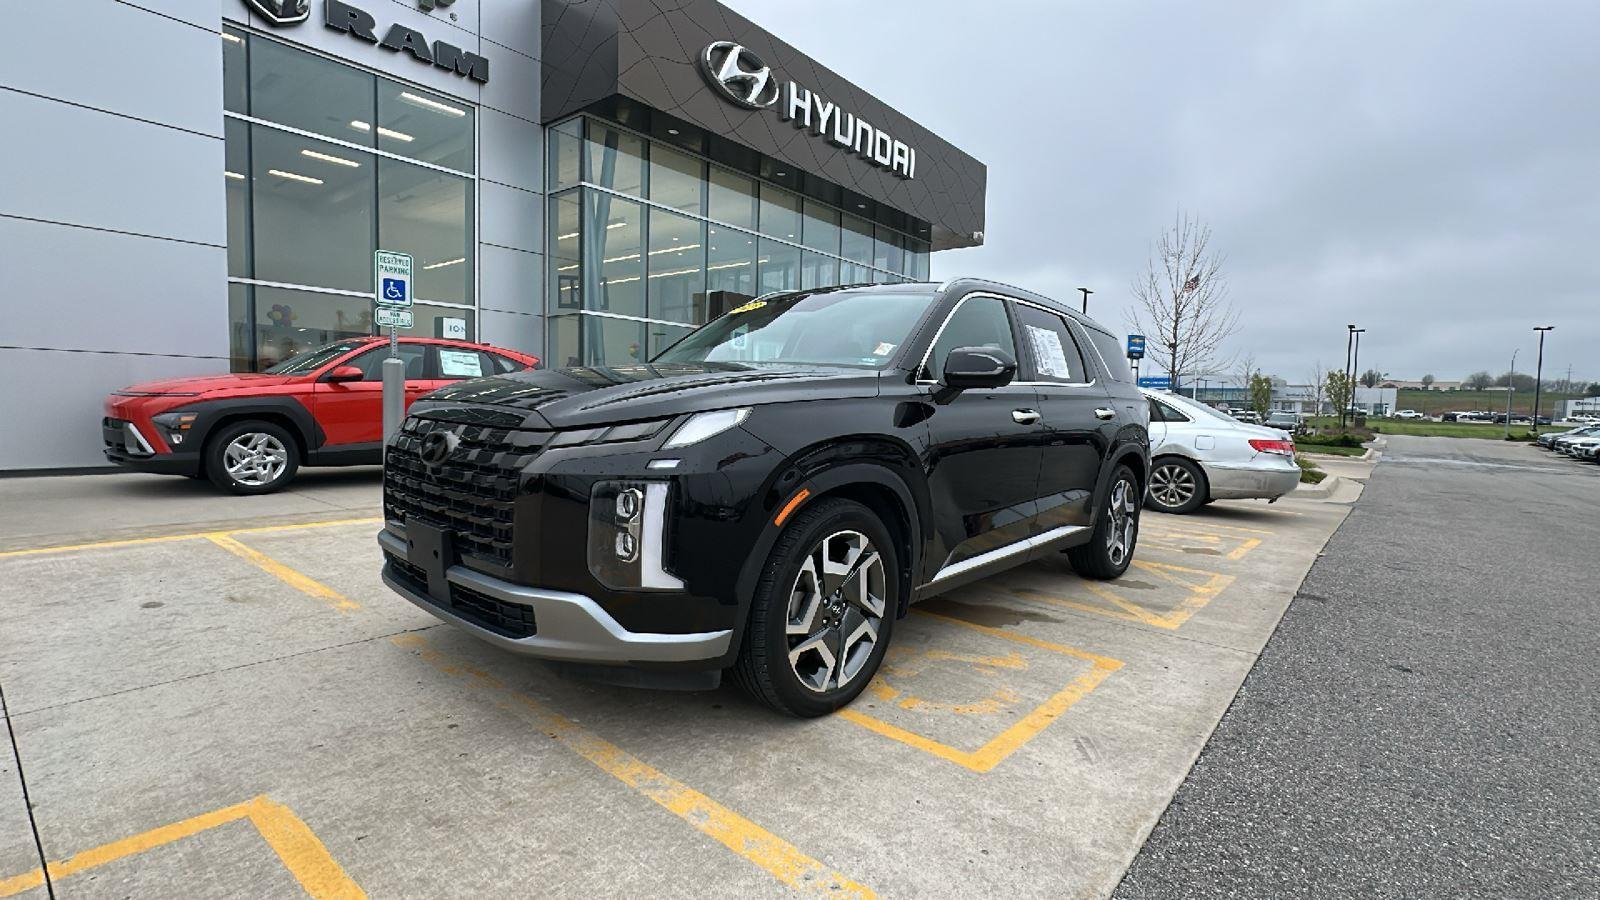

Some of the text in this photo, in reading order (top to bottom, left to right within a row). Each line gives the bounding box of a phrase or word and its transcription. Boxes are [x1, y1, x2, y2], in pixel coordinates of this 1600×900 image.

[325, 0, 489, 83] RAM
[785, 80, 916, 179] HYUNDAI
[379, 255, 410, 267] RESERVED
[379, 264, 410, 276] PARKING
